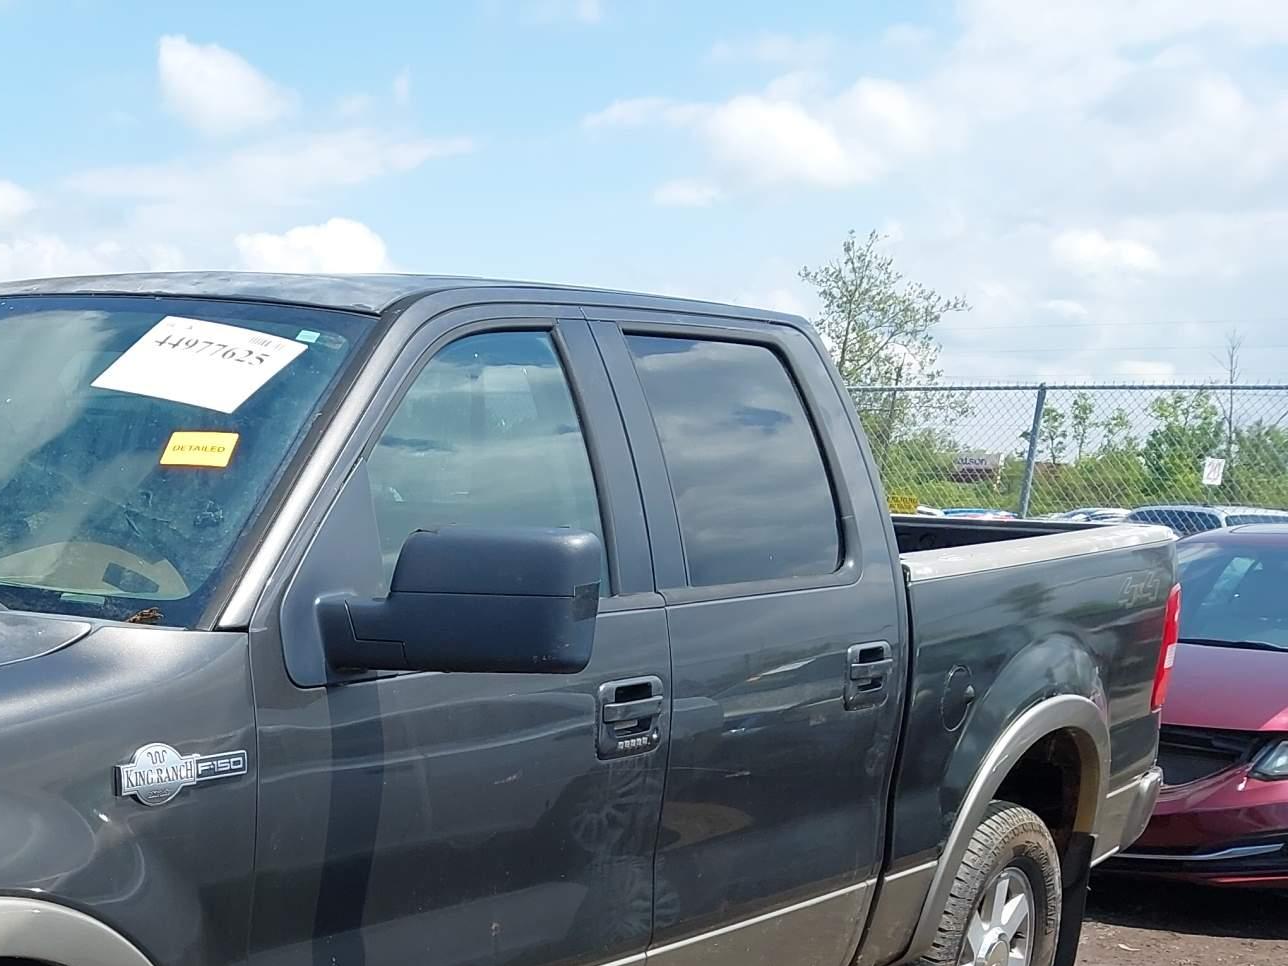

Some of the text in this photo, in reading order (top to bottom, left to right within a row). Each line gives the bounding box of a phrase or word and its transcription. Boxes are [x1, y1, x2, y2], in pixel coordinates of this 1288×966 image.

[155, 334, 271, 366] 44977625
[172, 445, 226, 453] DETAILED
[125, 760, 194, 789] KING RANCH
[198, 756, 244, 775] F-150
